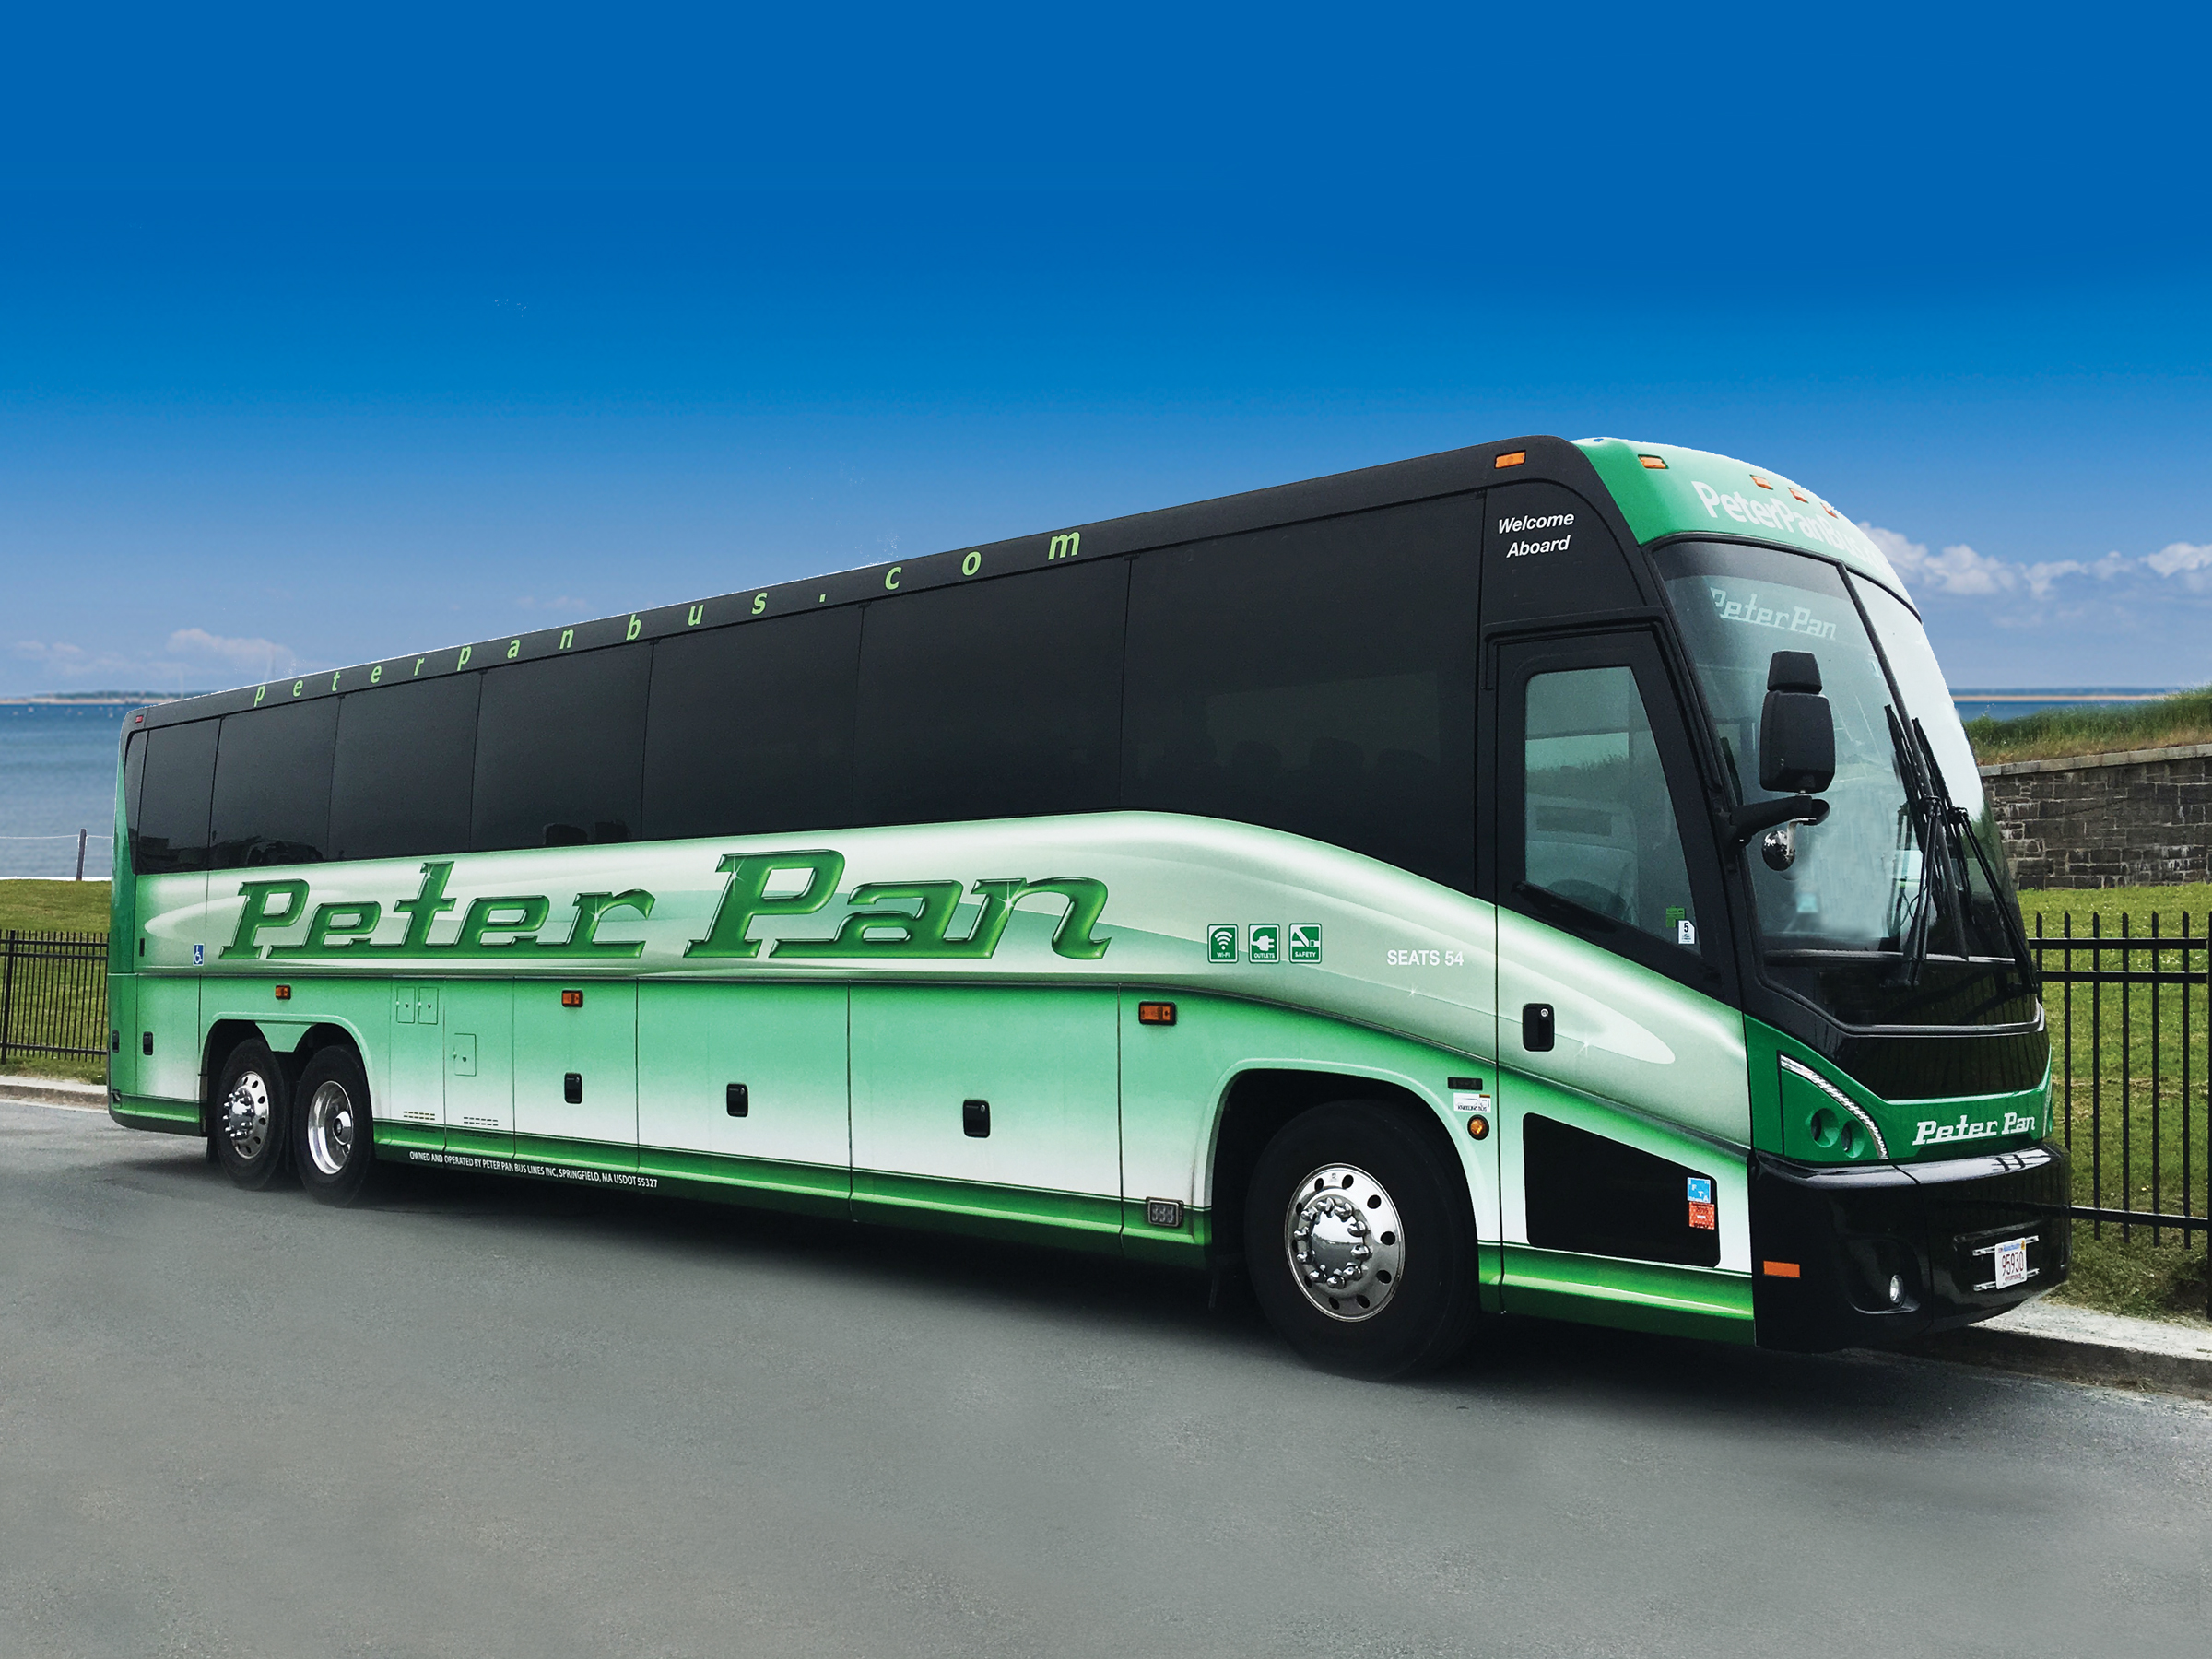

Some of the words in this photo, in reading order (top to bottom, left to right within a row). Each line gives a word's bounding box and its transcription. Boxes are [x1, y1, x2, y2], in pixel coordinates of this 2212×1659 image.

[1499, 513, 1575, 534] Welcome
[1506, 535, 1571, 558] Aboard
[1787, 606, 1837, 641] Pan
[218, 861, 656, 959] Peter
[682, 849, 1112, 960] Pan
[1683, 922, 1689, 933] 5
[1387, 949, 1440, 966] SEATS
[1444, 950, 1465, 966] 54
[1912, 1114, 1998, 1146] Peter
[2001, 1112, 2035, 1135] Pan
[409, 1150, 430, 1161] OWNED
[430, 1153, 443, 1163] AND
[444, 1155, 474, 1167] OPERATED
[474, 1159, 482, 1168] BY
[482, 1159, 500, 1170] PETER
[500, 1161, 513, 1171] PAN
[514, 1163, 527, 1173] BUS
[527, 1165, 544, 1175] LINES
[559, 1168, 601, 1182] SPRINGFIELD,
[602, 1172, 613, 1182] MA
[613, 1174, 637, 1185] USDOT
[637, 1178, 658, 1188] 55327
[2001, 1251, 2024, 1277] 95930
